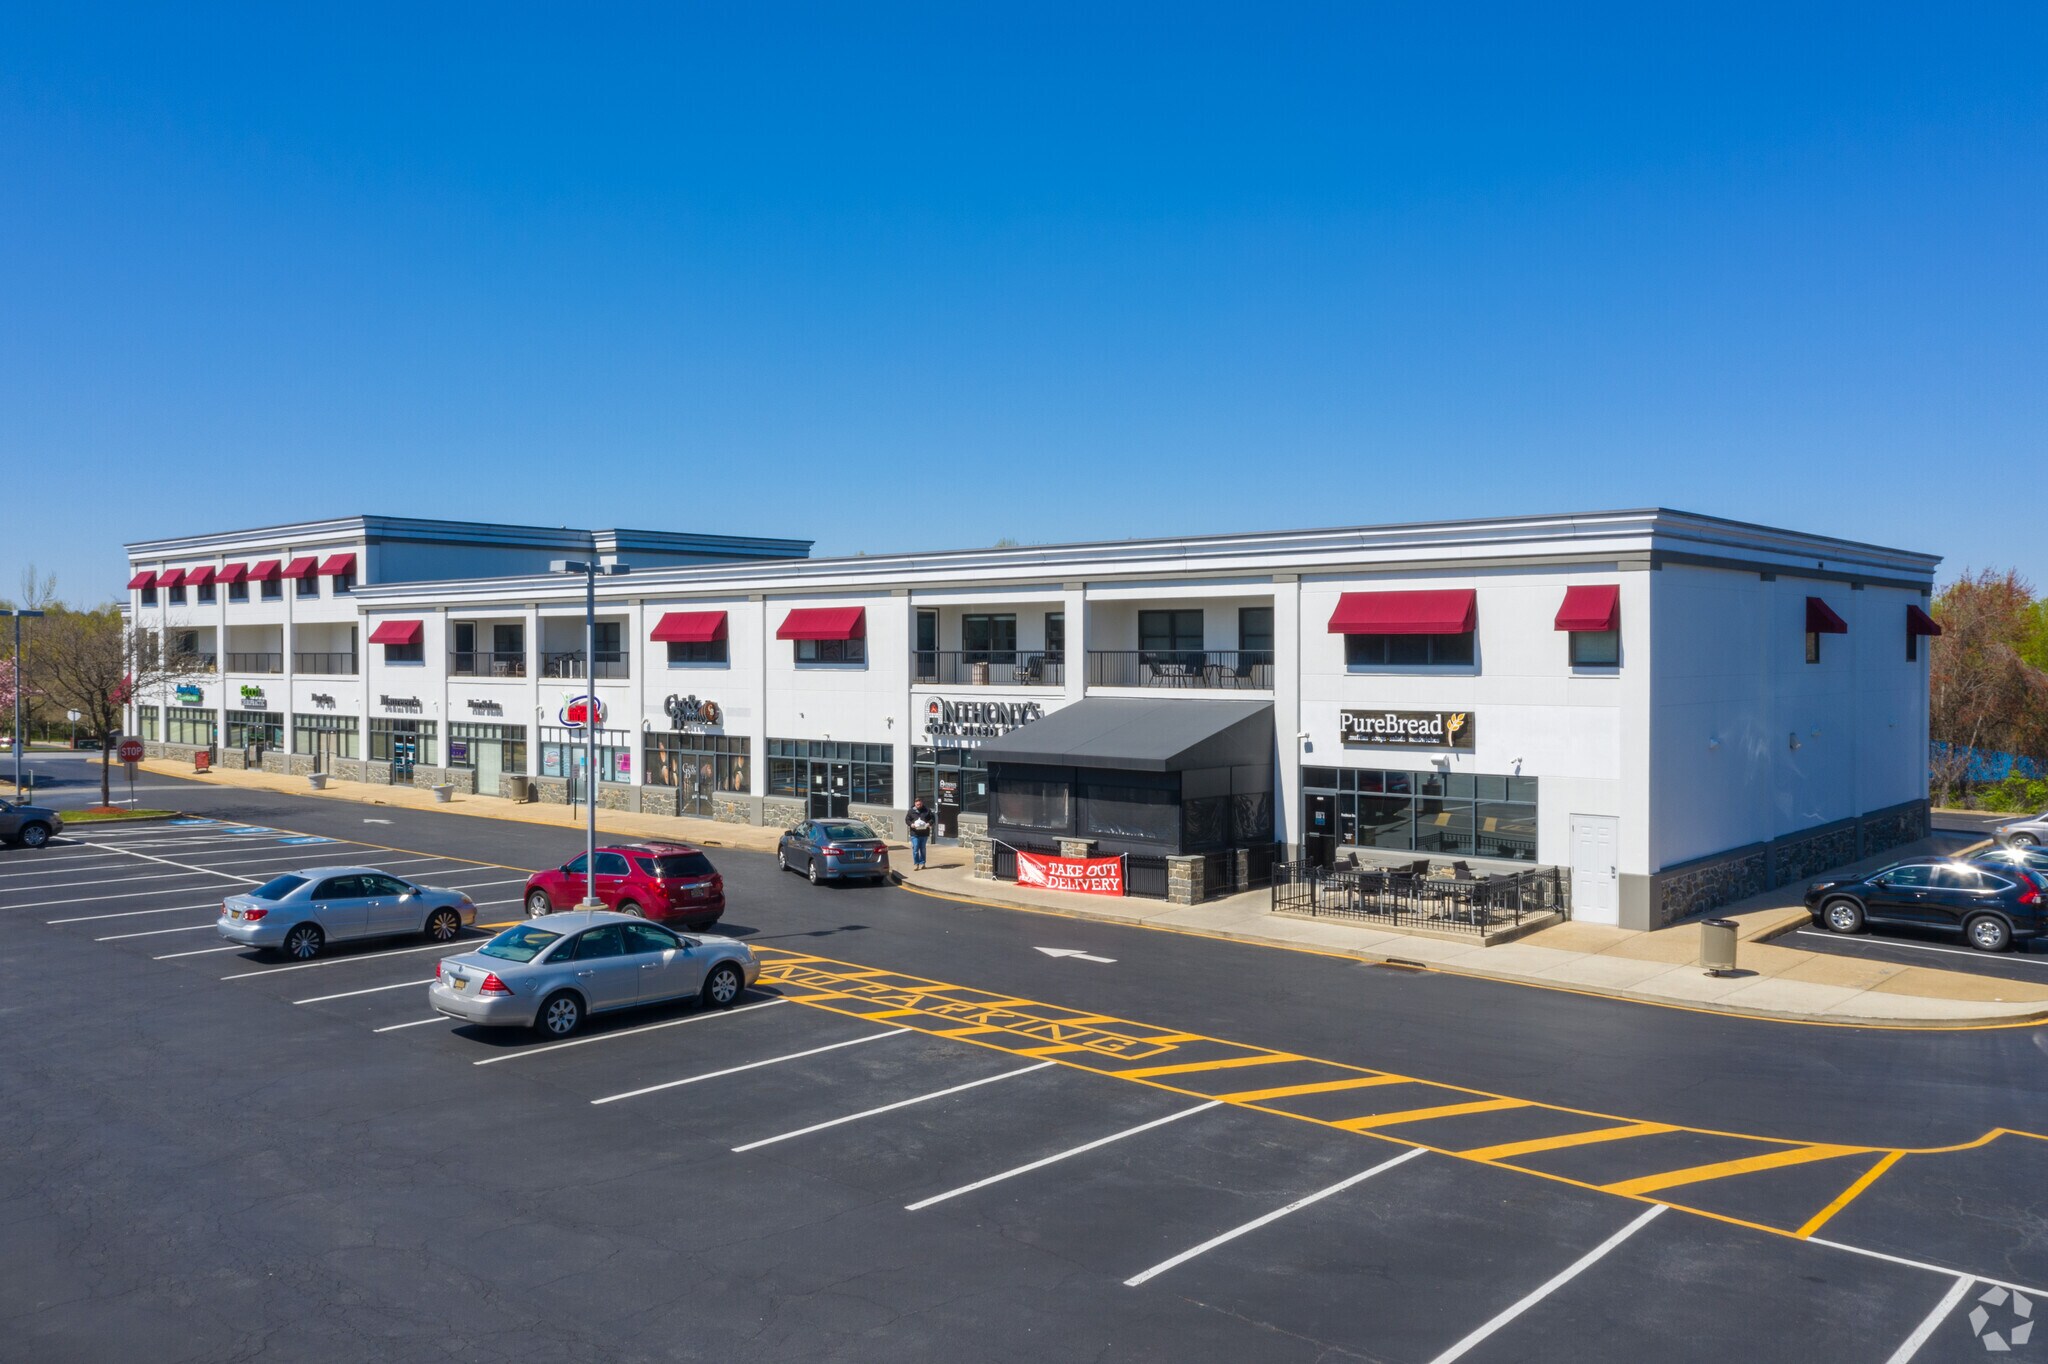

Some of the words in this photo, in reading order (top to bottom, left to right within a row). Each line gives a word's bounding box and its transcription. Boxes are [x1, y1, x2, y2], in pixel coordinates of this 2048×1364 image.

[925, 696, 1042, 725] ANTHONY'S
[925, 725, 955, 736] COAL
[960, 725, 996, 738] FIRED
[1341, 713, 1443, 735] PureBread
[121, 747, 142, 756] STOP
[1049, 863, 1083, 877] TAKE
[1086, 864, 1117, 877] OUT
[1046, 876, 1120, 891] DELIVERY
[758, 966, 848, 986] NO
[841, 985, 1137, 1052] PARKING
